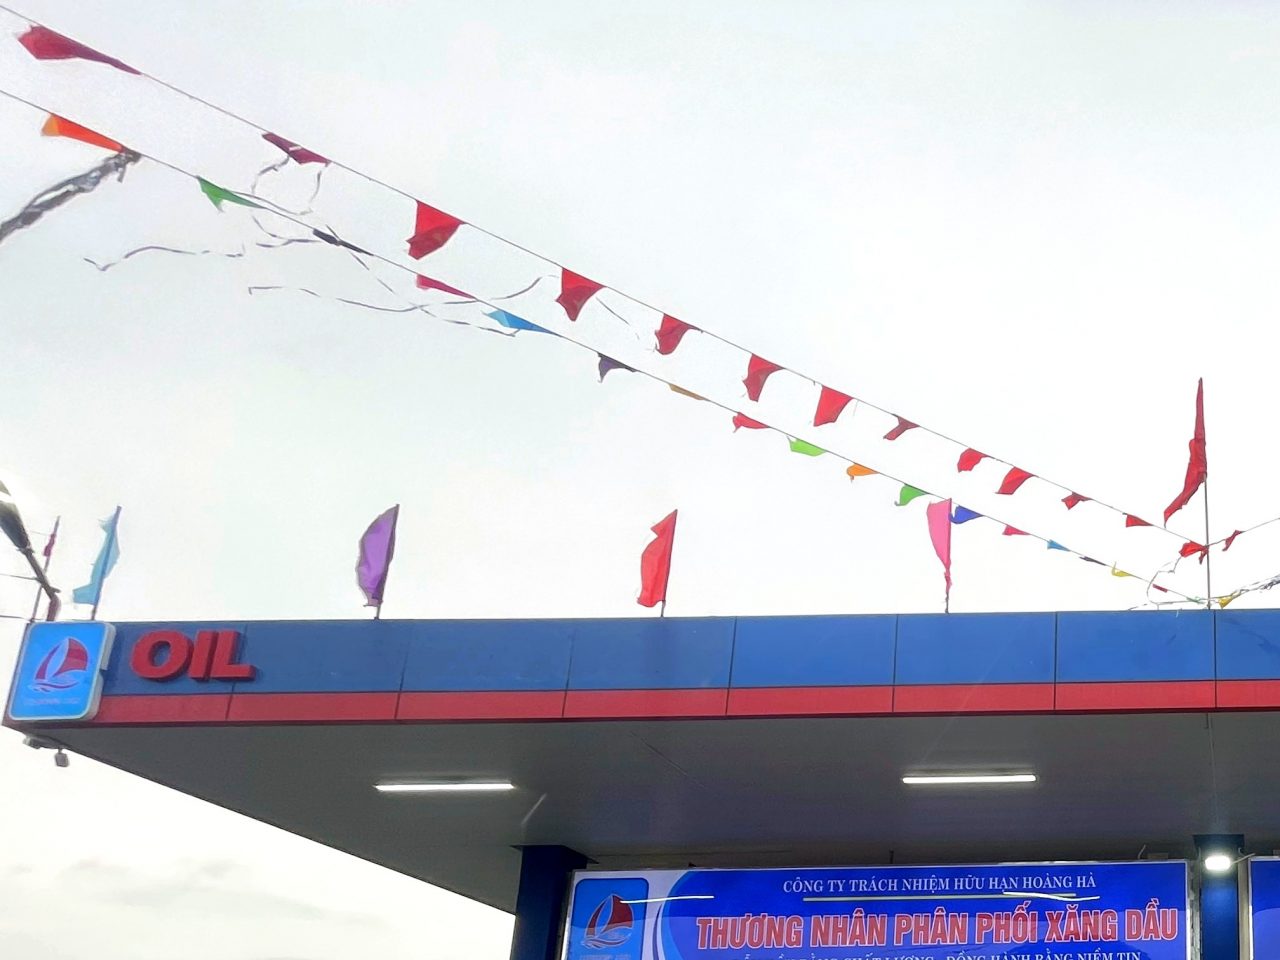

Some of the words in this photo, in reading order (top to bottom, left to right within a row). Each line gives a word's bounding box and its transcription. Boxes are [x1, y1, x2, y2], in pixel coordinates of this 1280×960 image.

[129, 630, 256, 681] OIL
[783, 878, 823, 893] CÔNG
[827, 879, 846, 892] TY
[849, 877, 898, 892] TRÁCH
[901, 875, 950, 894] NHIỆM
[953, 874, 985, 890] HỮU
[988, 875, 1019, 892] HẠN
[1022, 873, 1073, 890] HOÀNG
[1076, 872, 1097, 888] HÀ
[696, 912, 803, 950] THƯƠNG
[810, 908, 887, 947] NHÂN
[894, 906, 968, 945] PHÂN
[975, 900, 1037, 944] PHỐI
[1045, 904, 1118, 942] XĂNG
[1125, 898, 1178, 941] DẦU
